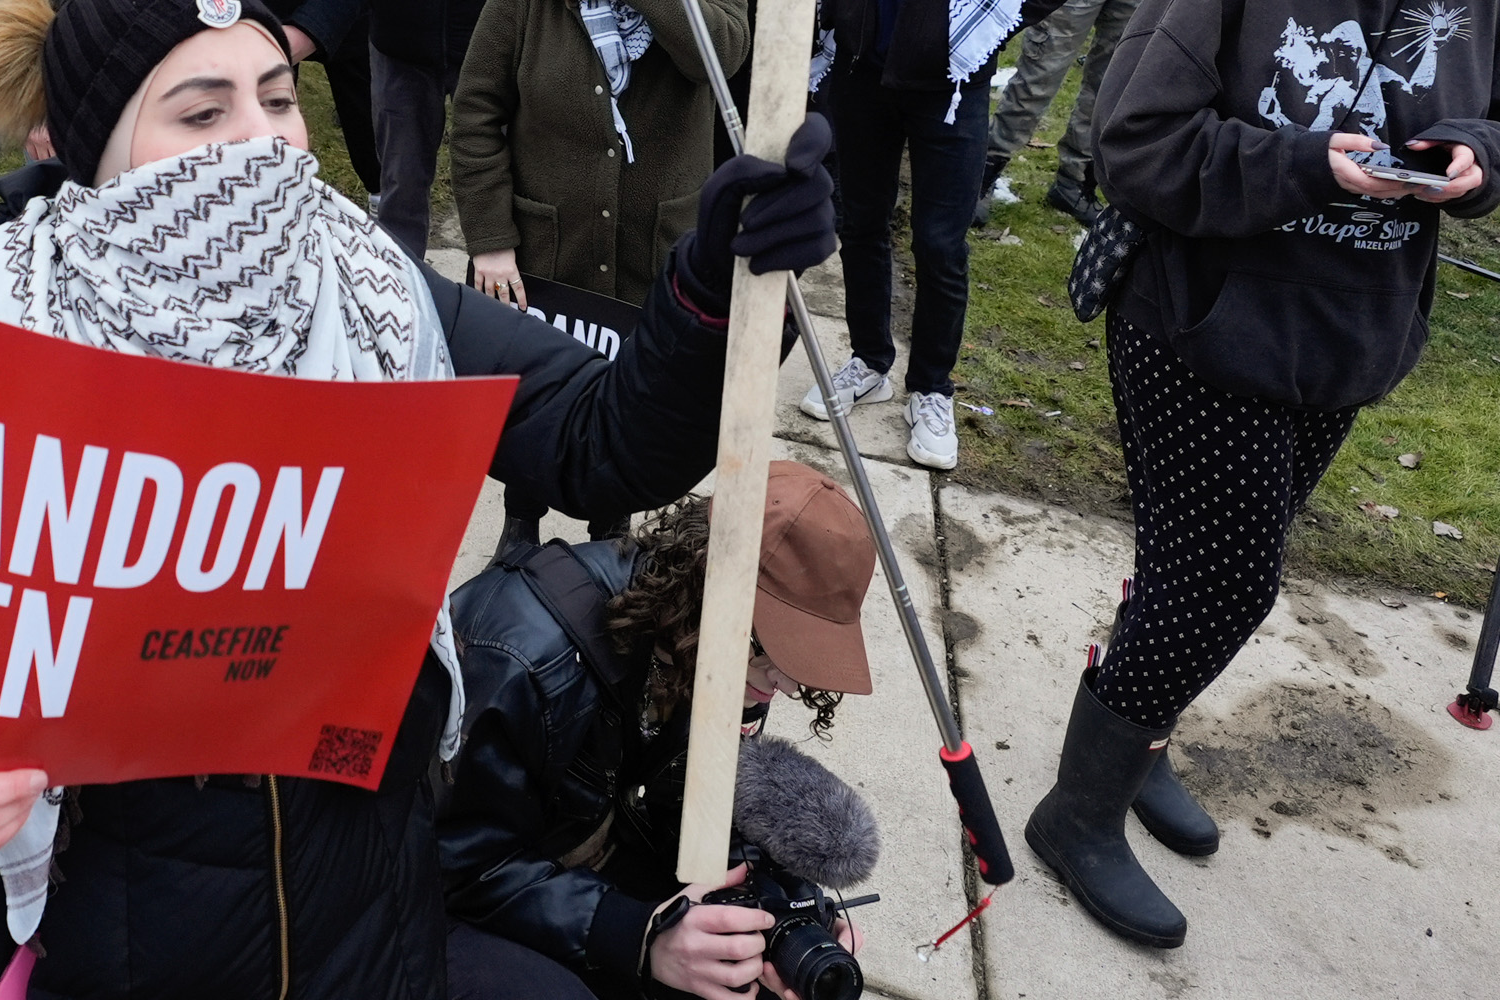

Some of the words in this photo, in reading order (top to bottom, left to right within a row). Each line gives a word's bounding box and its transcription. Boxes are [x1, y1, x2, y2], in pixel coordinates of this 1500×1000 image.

[1354, 240, 1383, 250] HAZEL
[140, 625, 291, 661] CEASEFIRE
[223, 658, 278, 682] NOW
[789, 899, 815, 909] Canon
